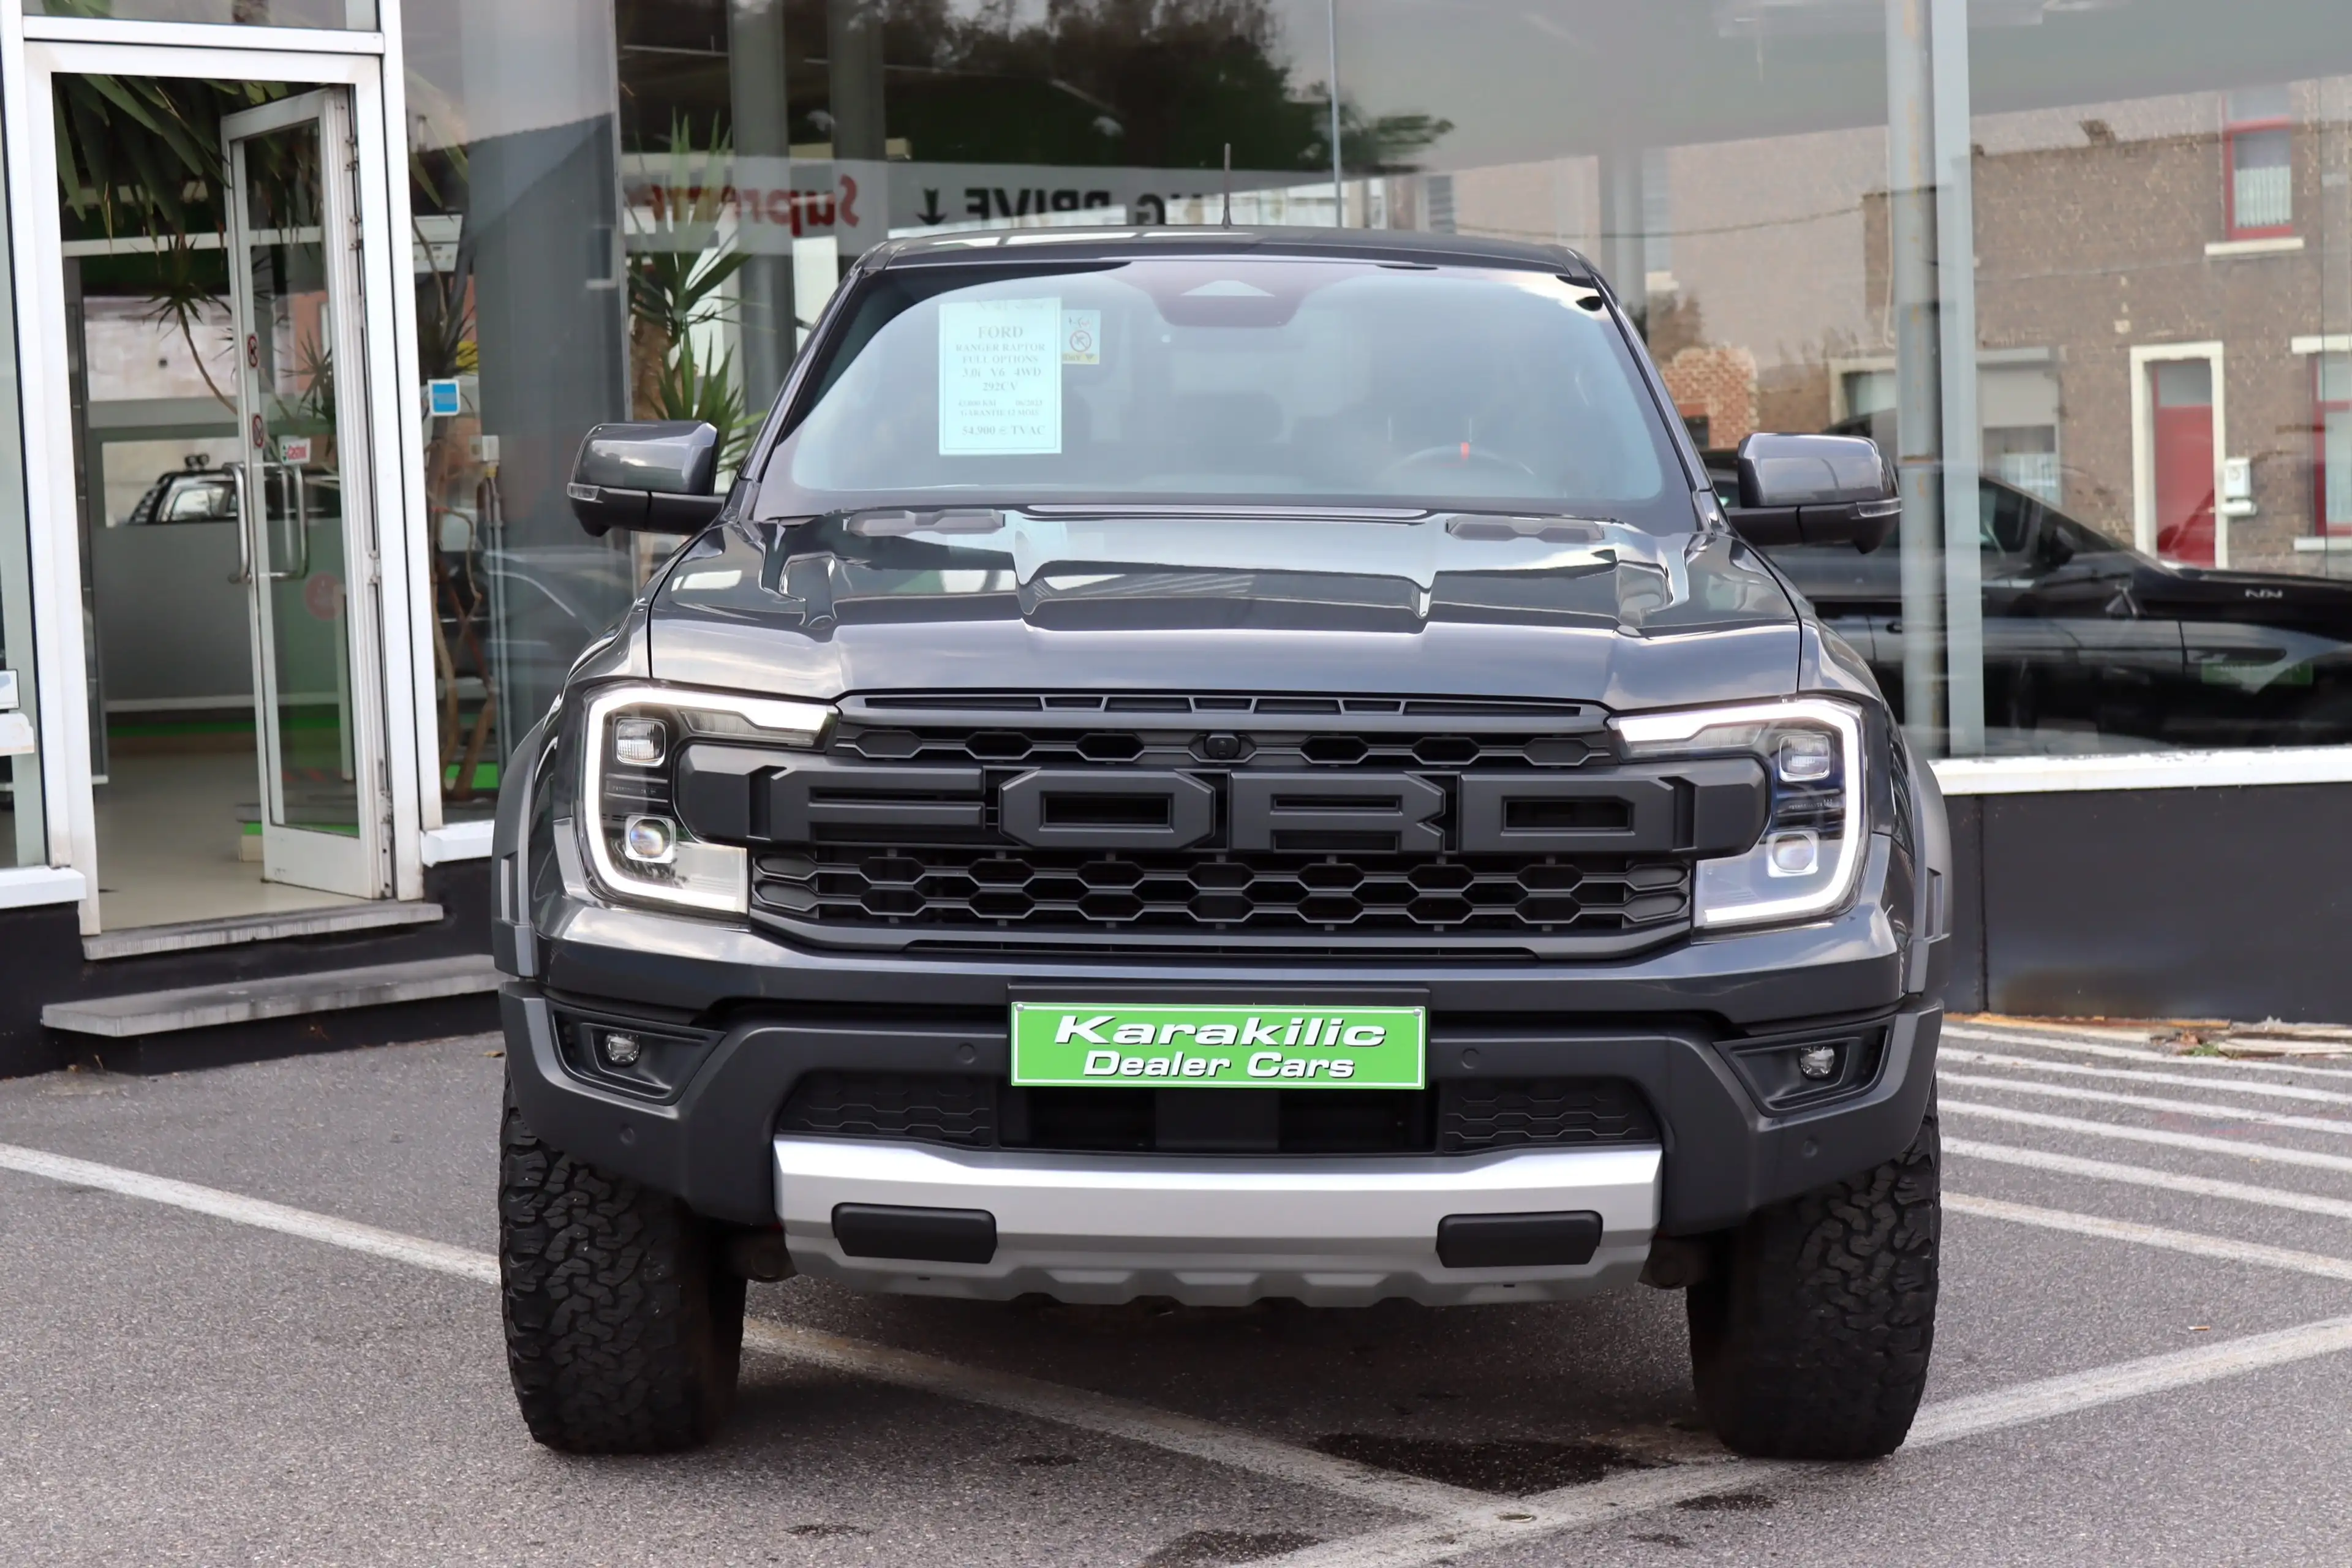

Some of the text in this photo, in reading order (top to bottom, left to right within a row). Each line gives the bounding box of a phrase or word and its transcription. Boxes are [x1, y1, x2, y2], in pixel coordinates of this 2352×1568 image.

[978, 325, 1023, 339] FORD
[956, 343, 1046, 352] RANGER RAPTOR
[963, 355, 1038, 364] FULL OPTIONS
[990, 367, 1006, 377] V6
[1014, 367, 1041, 377] 4WD
[962, 425, 996, 435] 54.900
[1011, 425, 1046, 435] TVAC
[771, 767, 1673, 855] FORD
[1054, 1015, 1386, 1047] Karakilic
[1083, 1050, 1355, 1079] Dealer Cars
